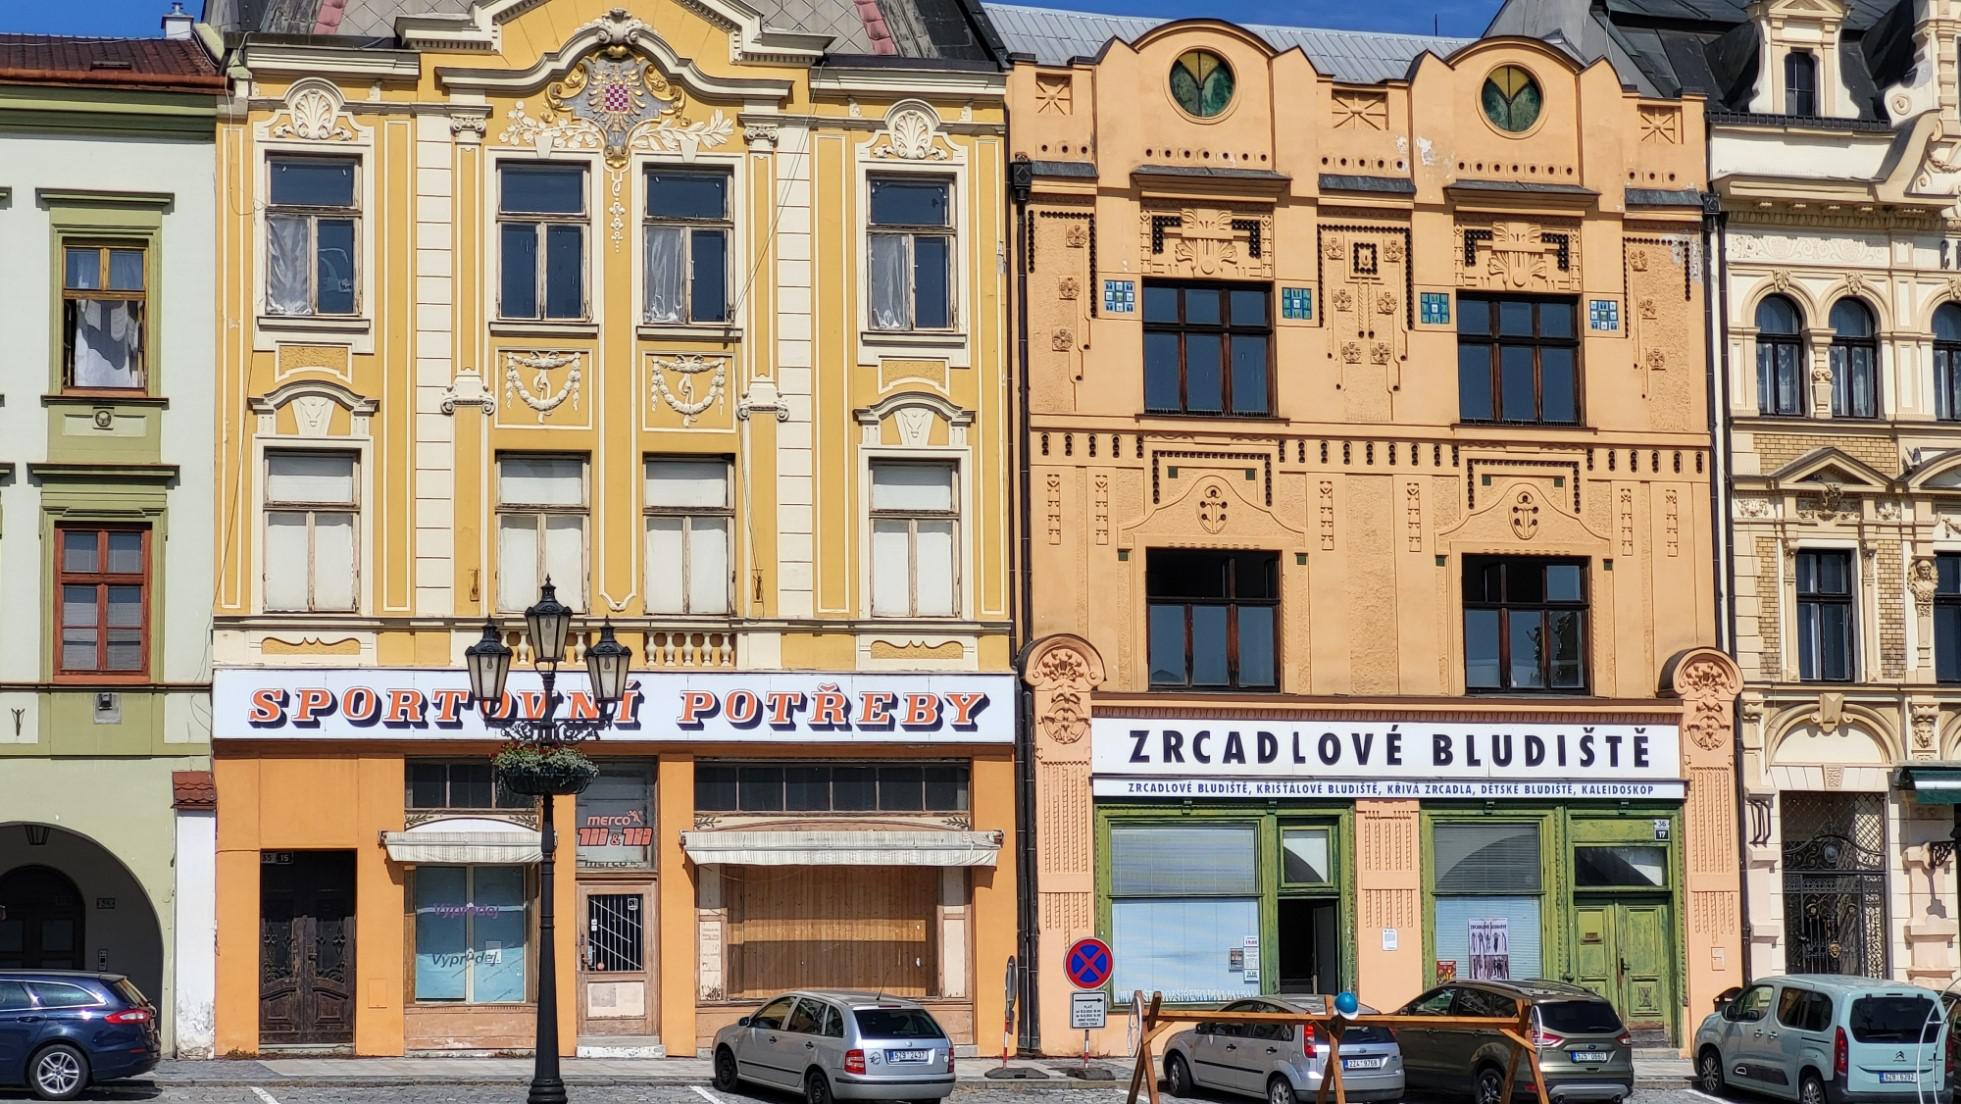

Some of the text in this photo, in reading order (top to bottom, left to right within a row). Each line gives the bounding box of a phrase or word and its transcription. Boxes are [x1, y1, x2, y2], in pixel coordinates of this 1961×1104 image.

[676, 682, 991, 733] POTŘEBY
[1129, 725, 1650, 769] ZRCADLOVÉ BLUDIŠTĚ
[1128, 781, 1192, 793] ZRCADLOVÉ
[1198, 781, 1252, 795] BLUDIŠTĚ,
[1328, 782, 1382, 796] BLUDIŠTĚ,
[1387, 782, 1420, 794] KŘIVÁ
[1425, 784, 1476, 796] ZRCADLA,
[1481, 782, 1519, 794] DĚTSKÉ
[1524, 783, 1577, 796] BLUDIŠTĚ,
[1582, 784, 1654, 795] KALEIDOSKOP
[587, 816, 631, 826] merco
[1658, 830, 1666, 838] 17
